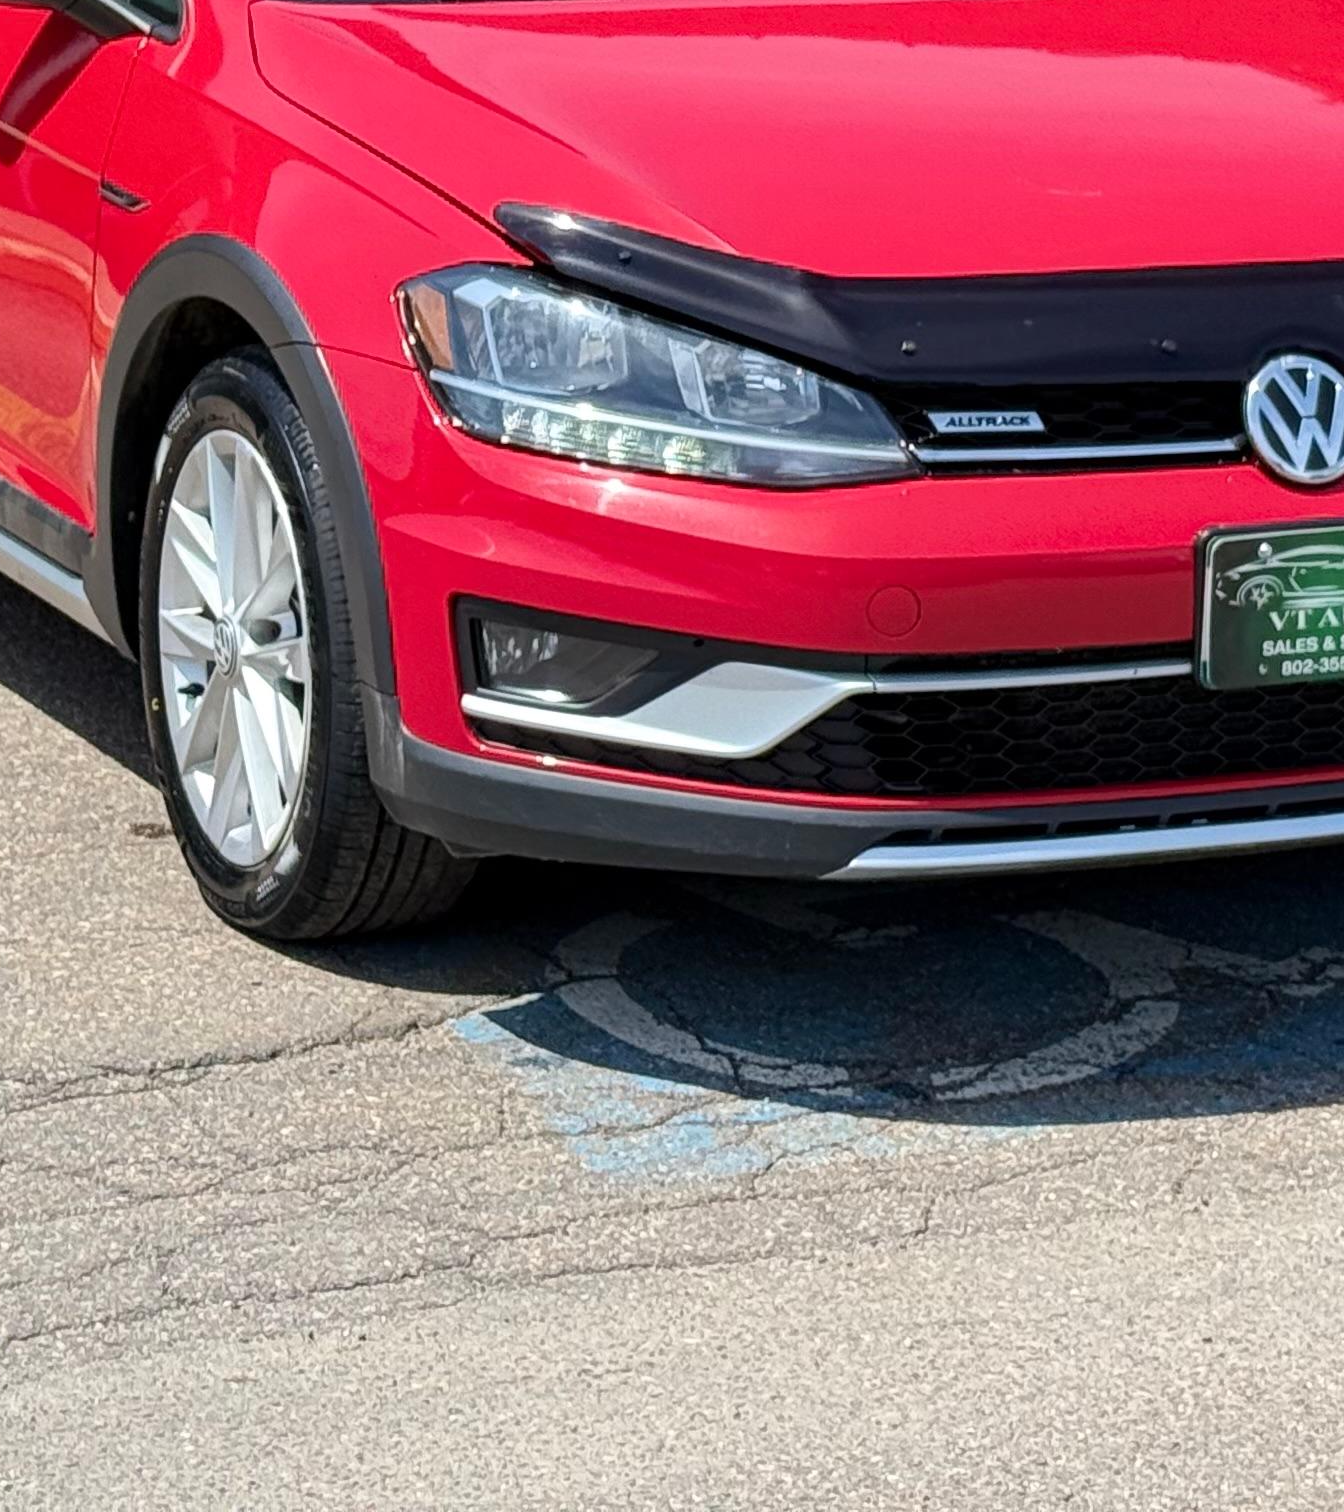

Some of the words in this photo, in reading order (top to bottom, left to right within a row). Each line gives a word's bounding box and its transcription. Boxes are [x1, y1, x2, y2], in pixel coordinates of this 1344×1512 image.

[944, 415, 1032, 428] ALLTRACK
[1268, 609, 1313, 632] VT
[1262, 636, 1319, 657] SALES
[1322, 635, 1337, 652] &
